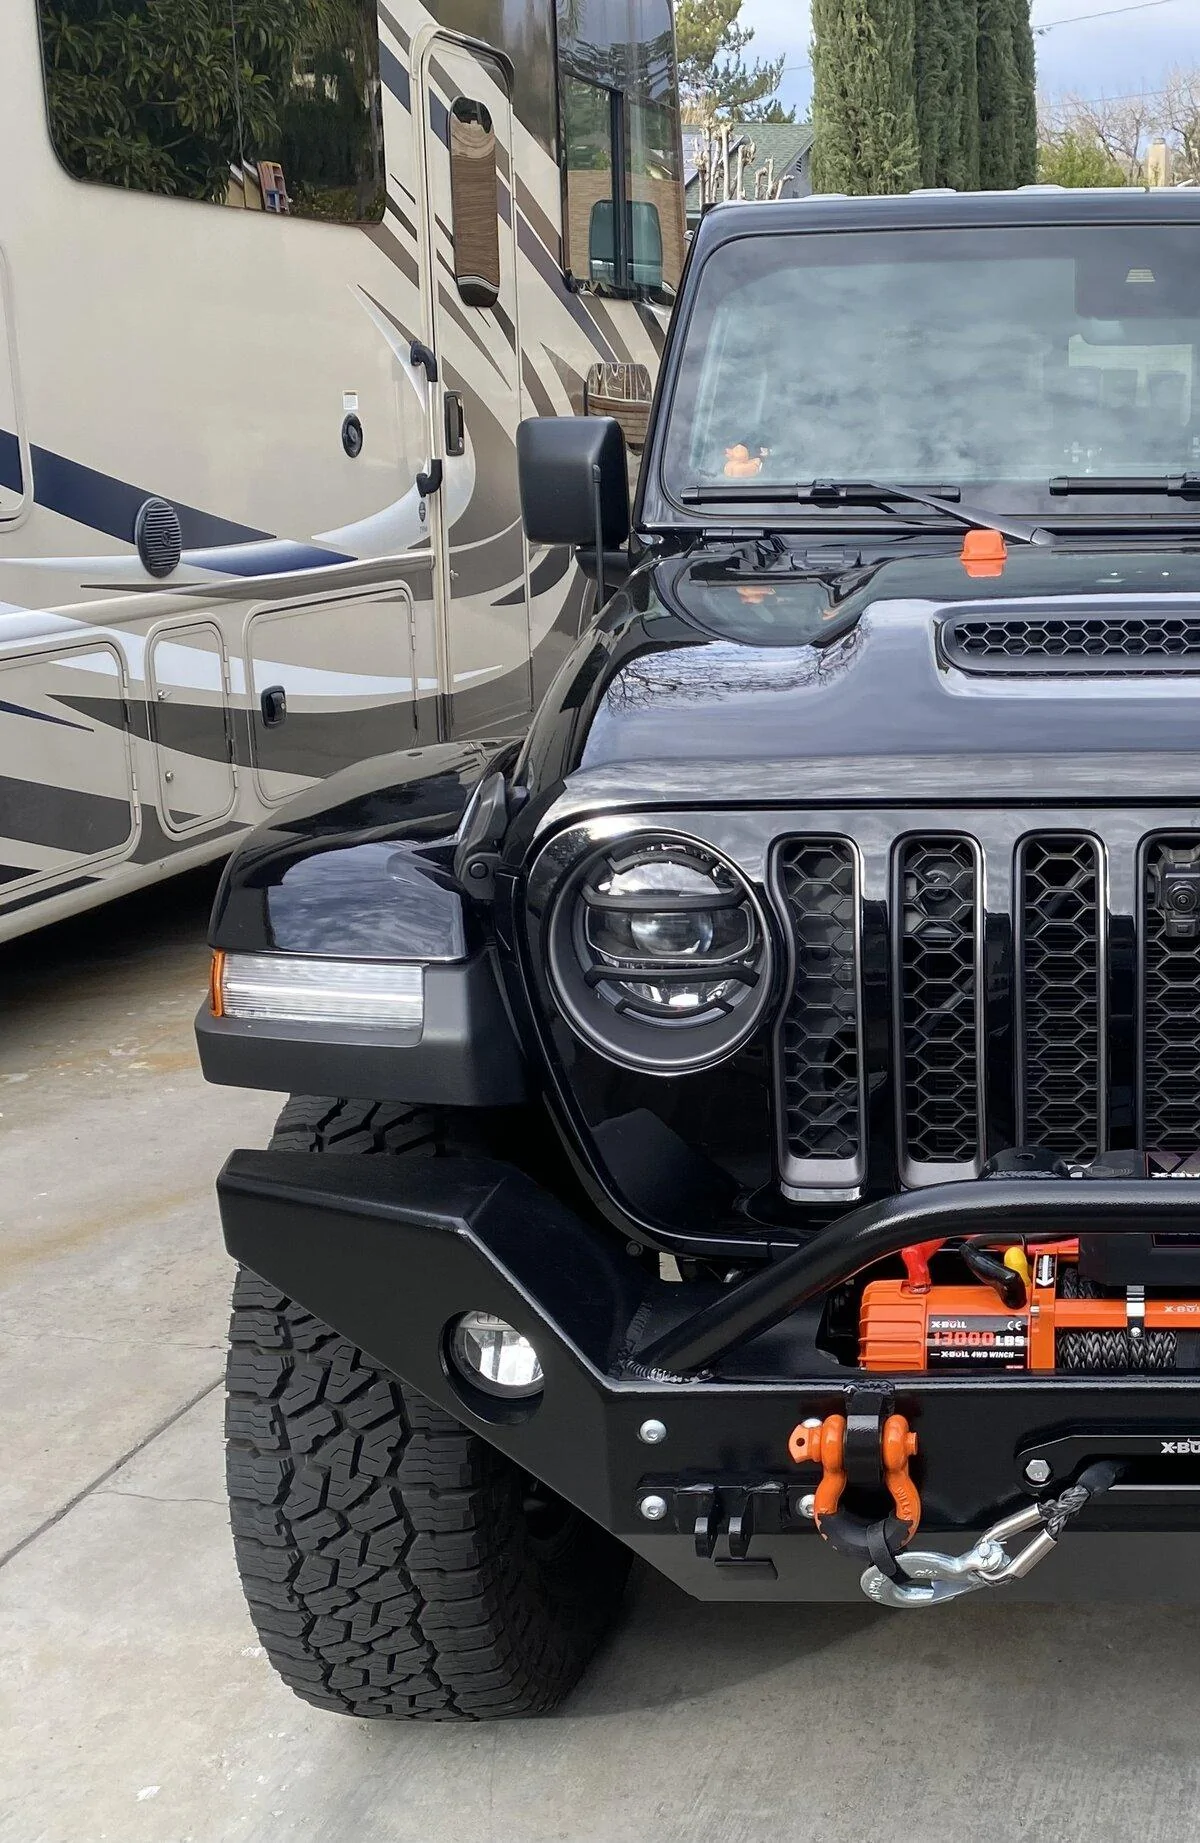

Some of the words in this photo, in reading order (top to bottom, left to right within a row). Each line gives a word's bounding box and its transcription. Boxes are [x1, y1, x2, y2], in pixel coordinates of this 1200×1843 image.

[931, 1320, 967, 1329] X-BULL
[940, 1350, 969, 1358] X-BULL
[971, 1351, 988, 1359] 4WD
[989, 1351, 1014, 1359] WINCH
